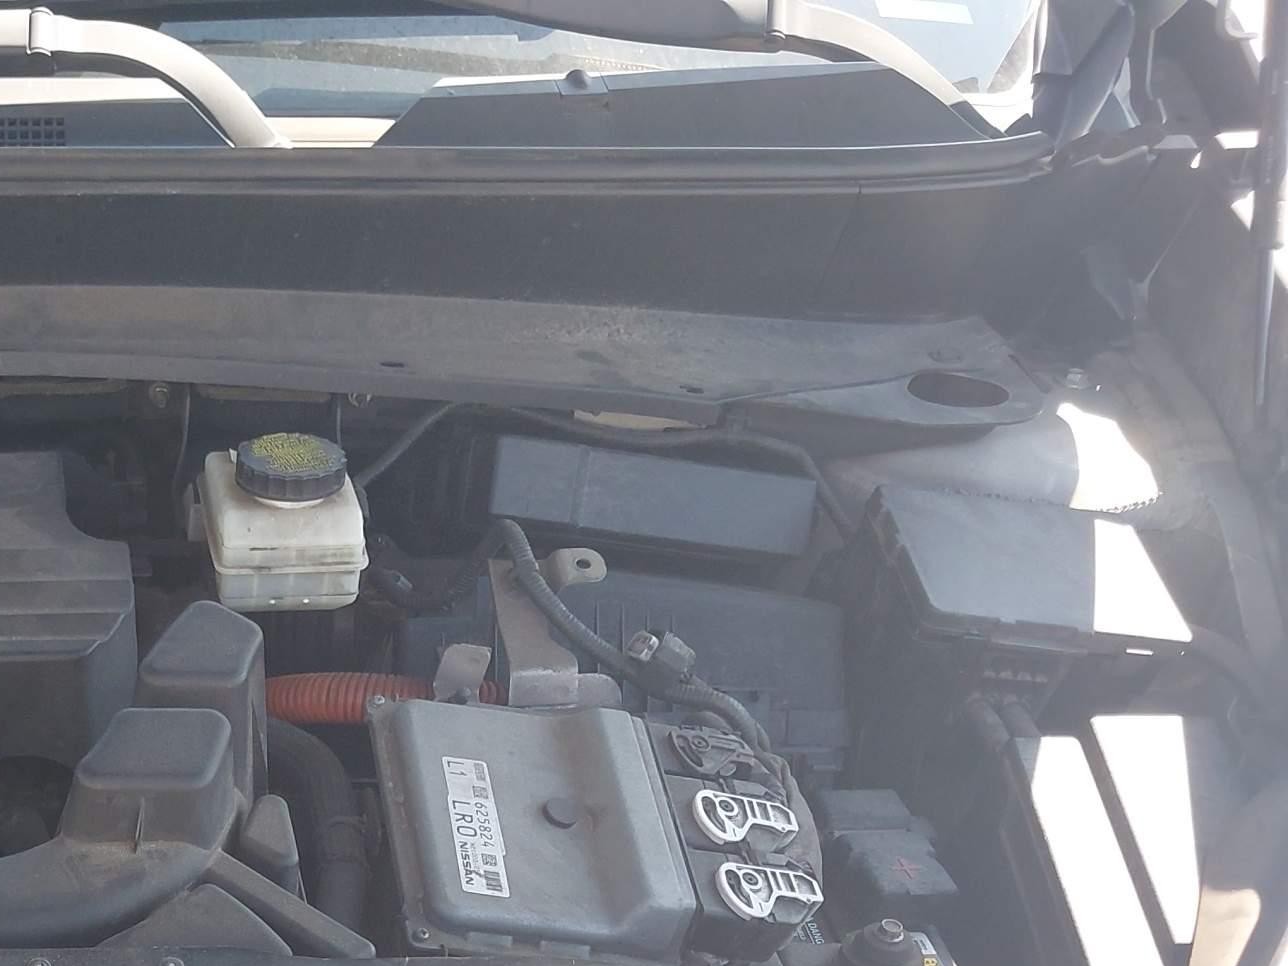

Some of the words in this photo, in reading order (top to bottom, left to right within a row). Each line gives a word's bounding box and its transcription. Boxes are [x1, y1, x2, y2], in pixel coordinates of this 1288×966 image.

[474, 801, 495, 847] 625824
[458, 840, 475, 886] NISSAN
[807, 922, 825, 945] DANG
